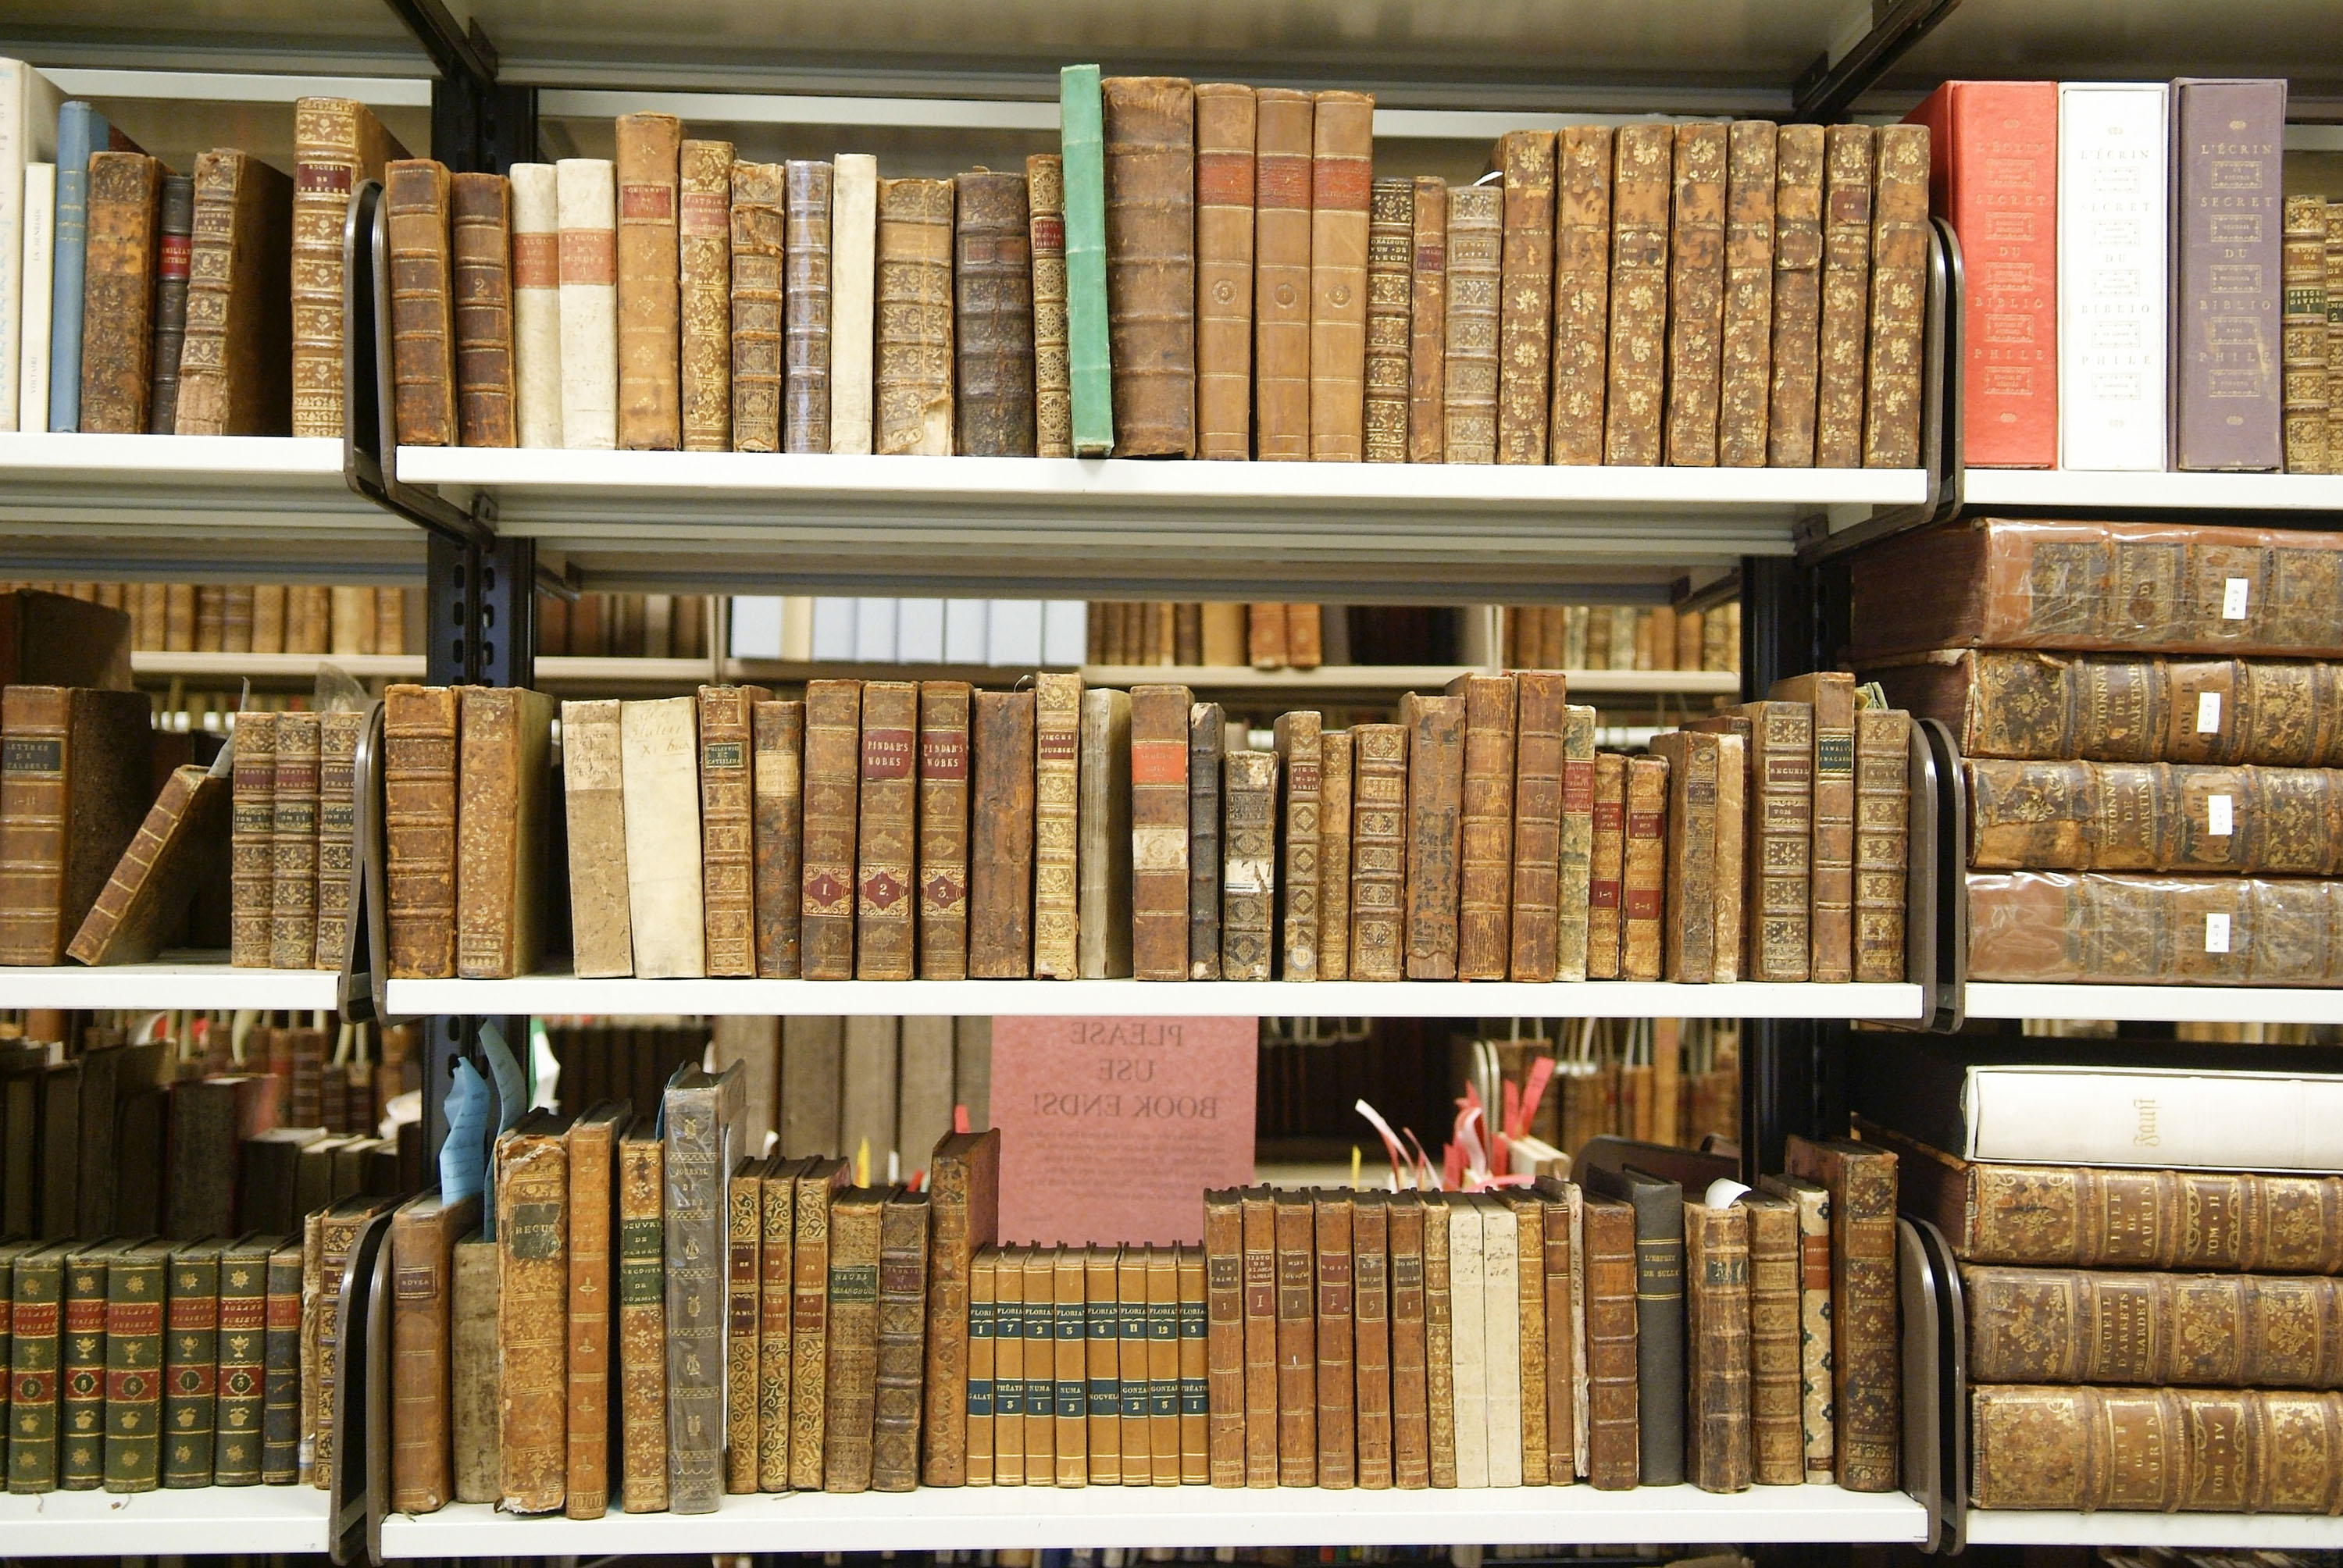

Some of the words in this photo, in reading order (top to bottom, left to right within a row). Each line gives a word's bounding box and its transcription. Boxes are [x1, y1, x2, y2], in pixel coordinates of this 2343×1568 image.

[2201, 142, 2272, 155] L'ÉCRIN
[1975, 194, 2045, 206] SECRET
[2200, 197, 2273, 207] SECRET
[1999, 246, 2021, 257] DU
[2224, 248, 2248, 258] DU
[2106, 253, 2126, 263] DU
[475, 278, 484, 292] 2
[1336, 292, 1344, 301] 2
[1974, 297, 2044, 308] BIBLIO
[2199, 300, 2271, 311] BIBLIO
[2081, 304, 2150, 314] BIBLIO
[1974, 348, 2045, 360] PHILE
[2199, 352, 2272, 362] PHILE
[2082, 355, 2152, 365] PHILE
[2115, 696, 2125, 716] DE
[868, 741, 908, 752] PINDAR'S
[923, 744, 964, 754] PINDAR'S
[868, 757, 901, 767] WORKS
[927, 758, 959, 768] WORKS
[2123, 800, 2134, 821] DE
[2127, 1213, 2137, 1232] DE
[2207, 1223, 2220, 1256] TOM
[1368, 1300, 1375, 1311] 5
[223, 1315, 264, 1324] FURIEUX
[1007, 1324, 1015, 1333] 7
[1036, 1326, 1043, 1335] 2
[1157, 1326, 1168, 1335] 12
[2117, 1292, 2130, 1369] D'ARRETS
[2136, 1296, 2148, 1357] BARDET
[1132, 1402, 1139, 1410] 2
[2215, 1422, 2226, 1440] IV
[2213, 1464, 2225, 1494] TOM
